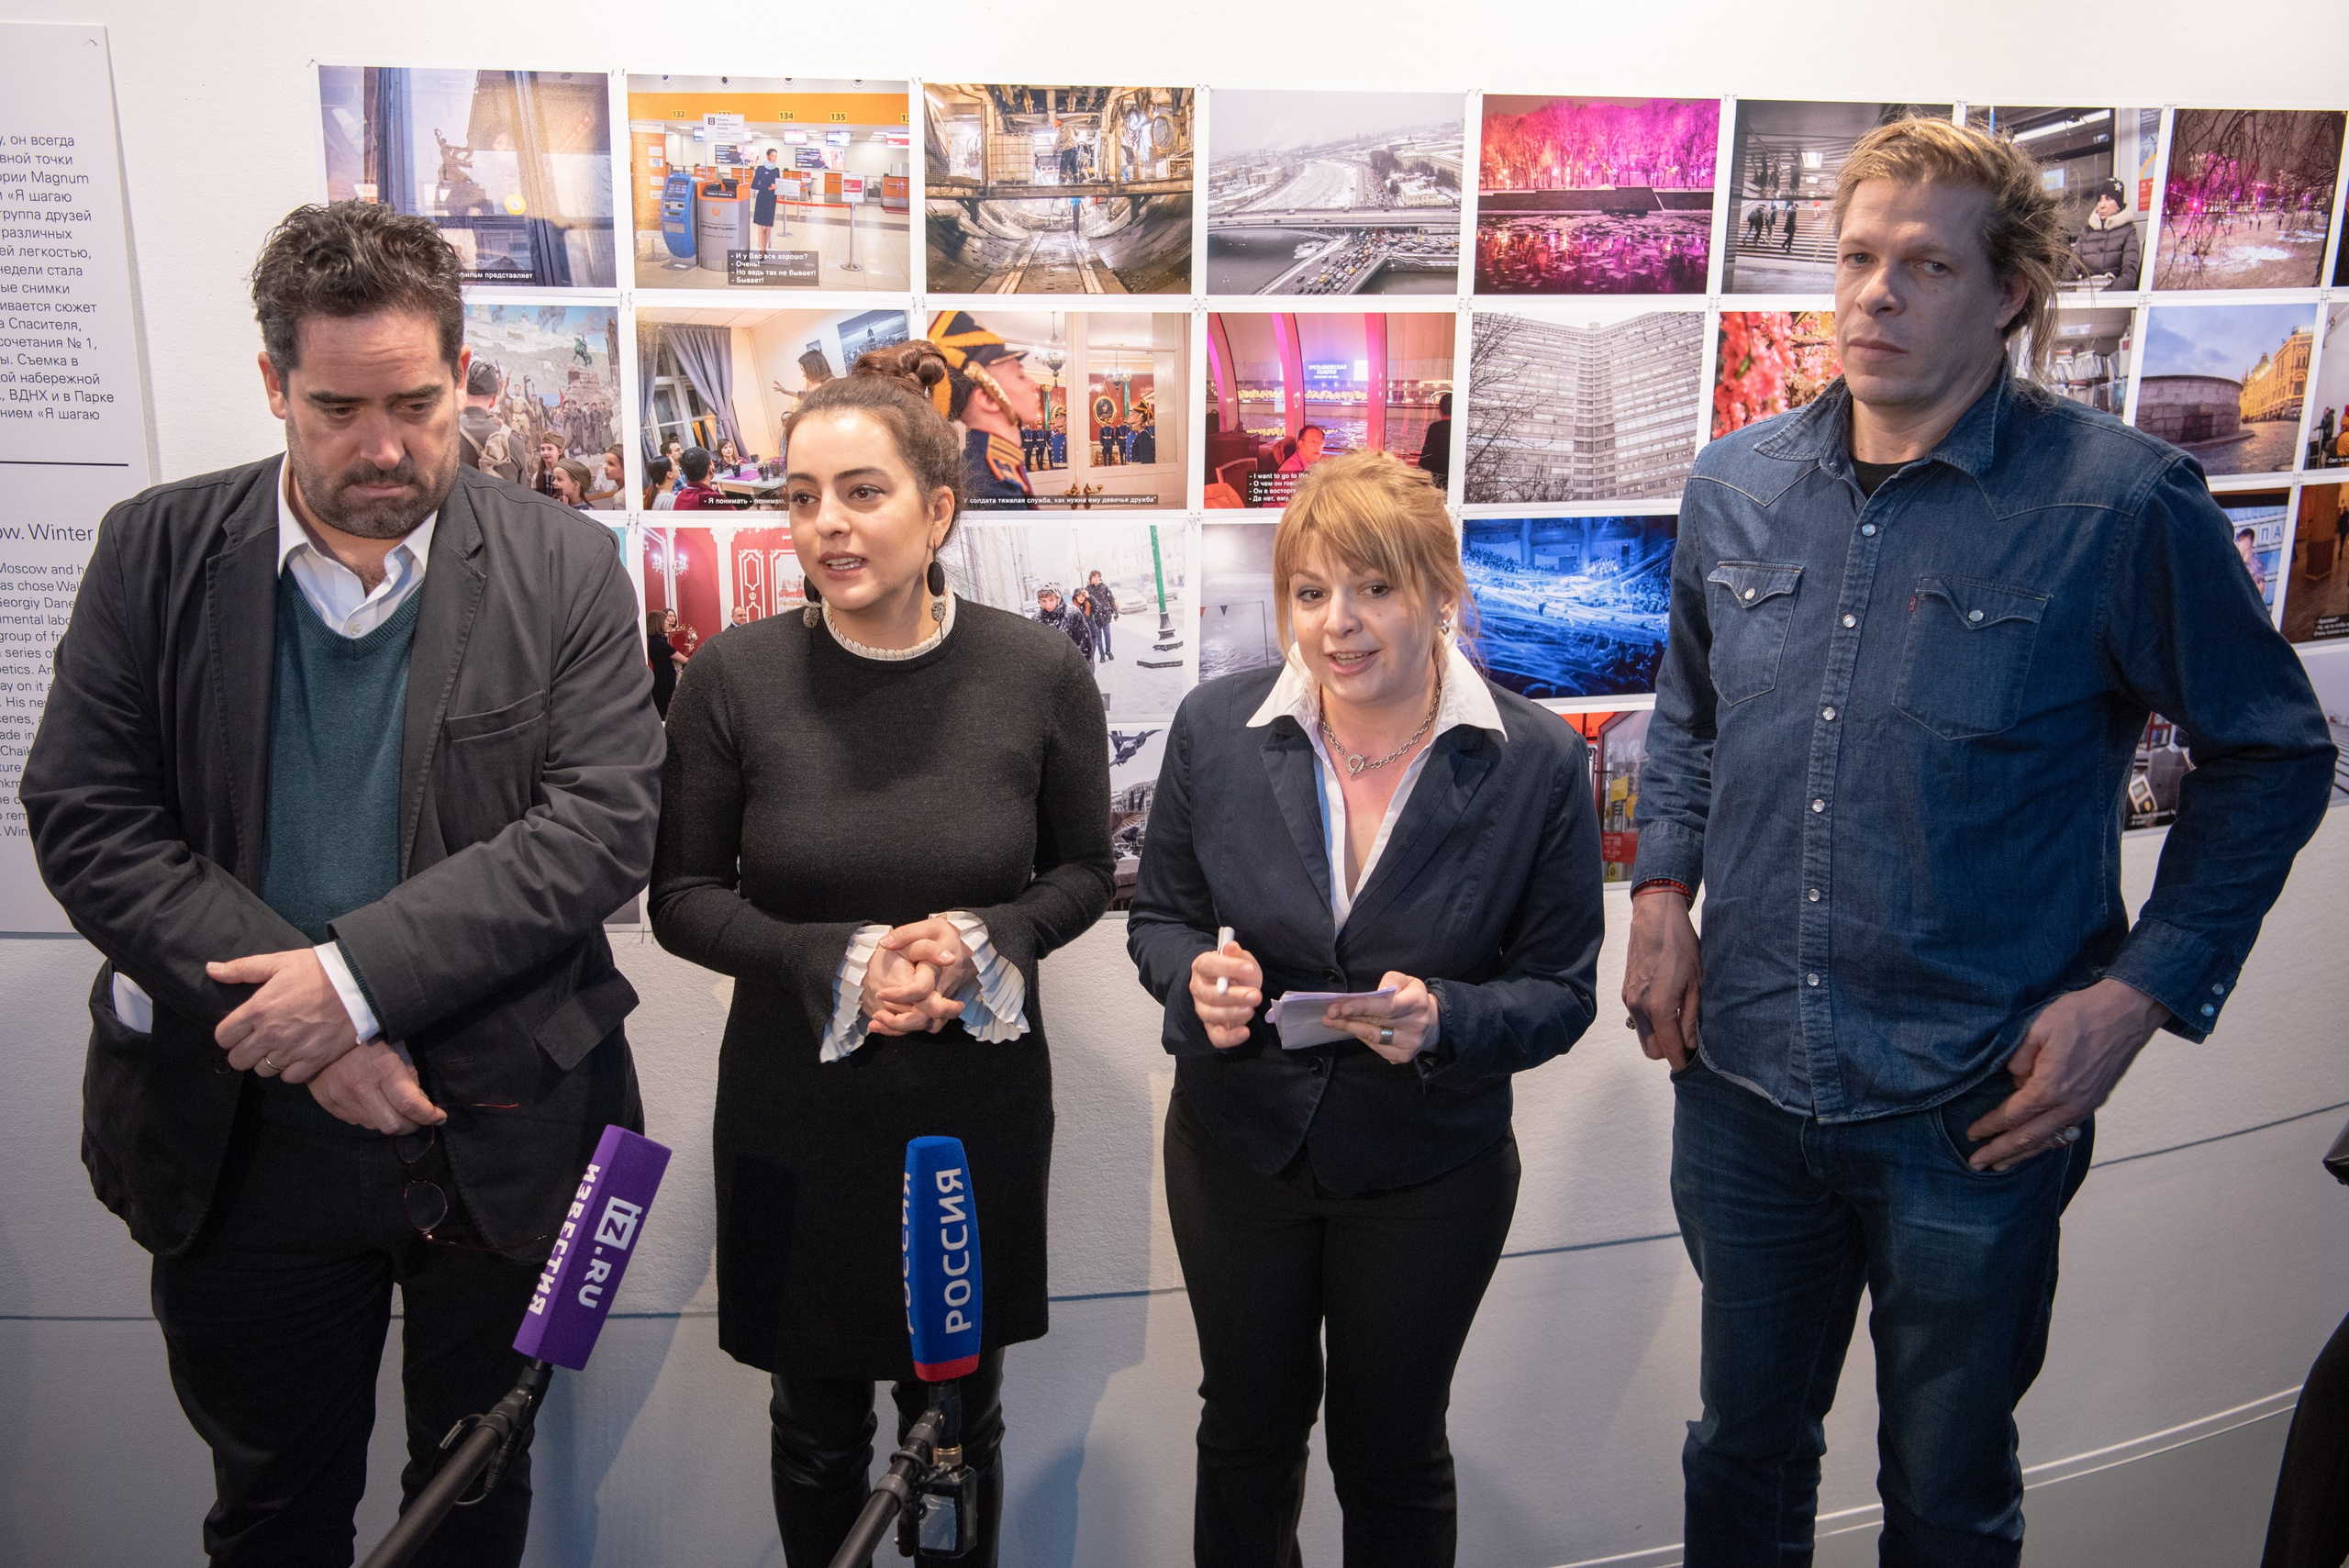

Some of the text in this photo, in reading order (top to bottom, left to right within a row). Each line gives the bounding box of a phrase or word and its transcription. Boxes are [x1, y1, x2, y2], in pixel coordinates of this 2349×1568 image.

[10, 136, 26, 145] он
[31, 136, 74, 148] всегда
[35, 155, 73, 165] точки
[31, 171, 89, 186] Magnum
[8, 189, 24, 201] «Я
[29, 192, 72, 202] шагаю
[45, 210, 91, 223] друзей
[2, 229, 72, 240] различных
[19, 248, 91, 259] легкостью,
[47, 267, 83, 276] стала
[22, 284, 70, 294] снимки
[0, 302, 96, 313] ивается сюжет
[9, 317, 81, 332] Спасителя,
[67, 337, 81, 348] №
[86, 338, 97, 350] 1,
[17, 353, 67, 366] Съемка
[71, 358, 78, 366] в
[0, 372, 100, 386] ой набережной
[9, 389, 48, 402] ВДНХ
[52, 393, 59, 402] и
[64, 393, 71, 402] в
[75, 390, 114, 404] Парке
[38, 407, 54, 419] «Я
[59, 411, 100, 420] шагаю
[0, 523, 93, 541] w. Winter
[51, 564, 73, 575] and
[0, 582, 14, 591] as
[18, 580, 54, 591] chose
[0, 597, 75, 610] eorgiy Dane
[35, 631, 47, 642] of
[5, 648, 41, 658] series
[0, 664, 34, 674] etics.
[0, 682, 13, 693] ay
[17, 683, 31, 691] on
[36, 681, 44, 691] it
[6, 697, 25, 708] His
[0, 715, 34, 726] enes,
[528, 1164, 600, 1315] ИЗВЕСТИЯ
[935, 1168, 972, 1334] РОССИЯ
